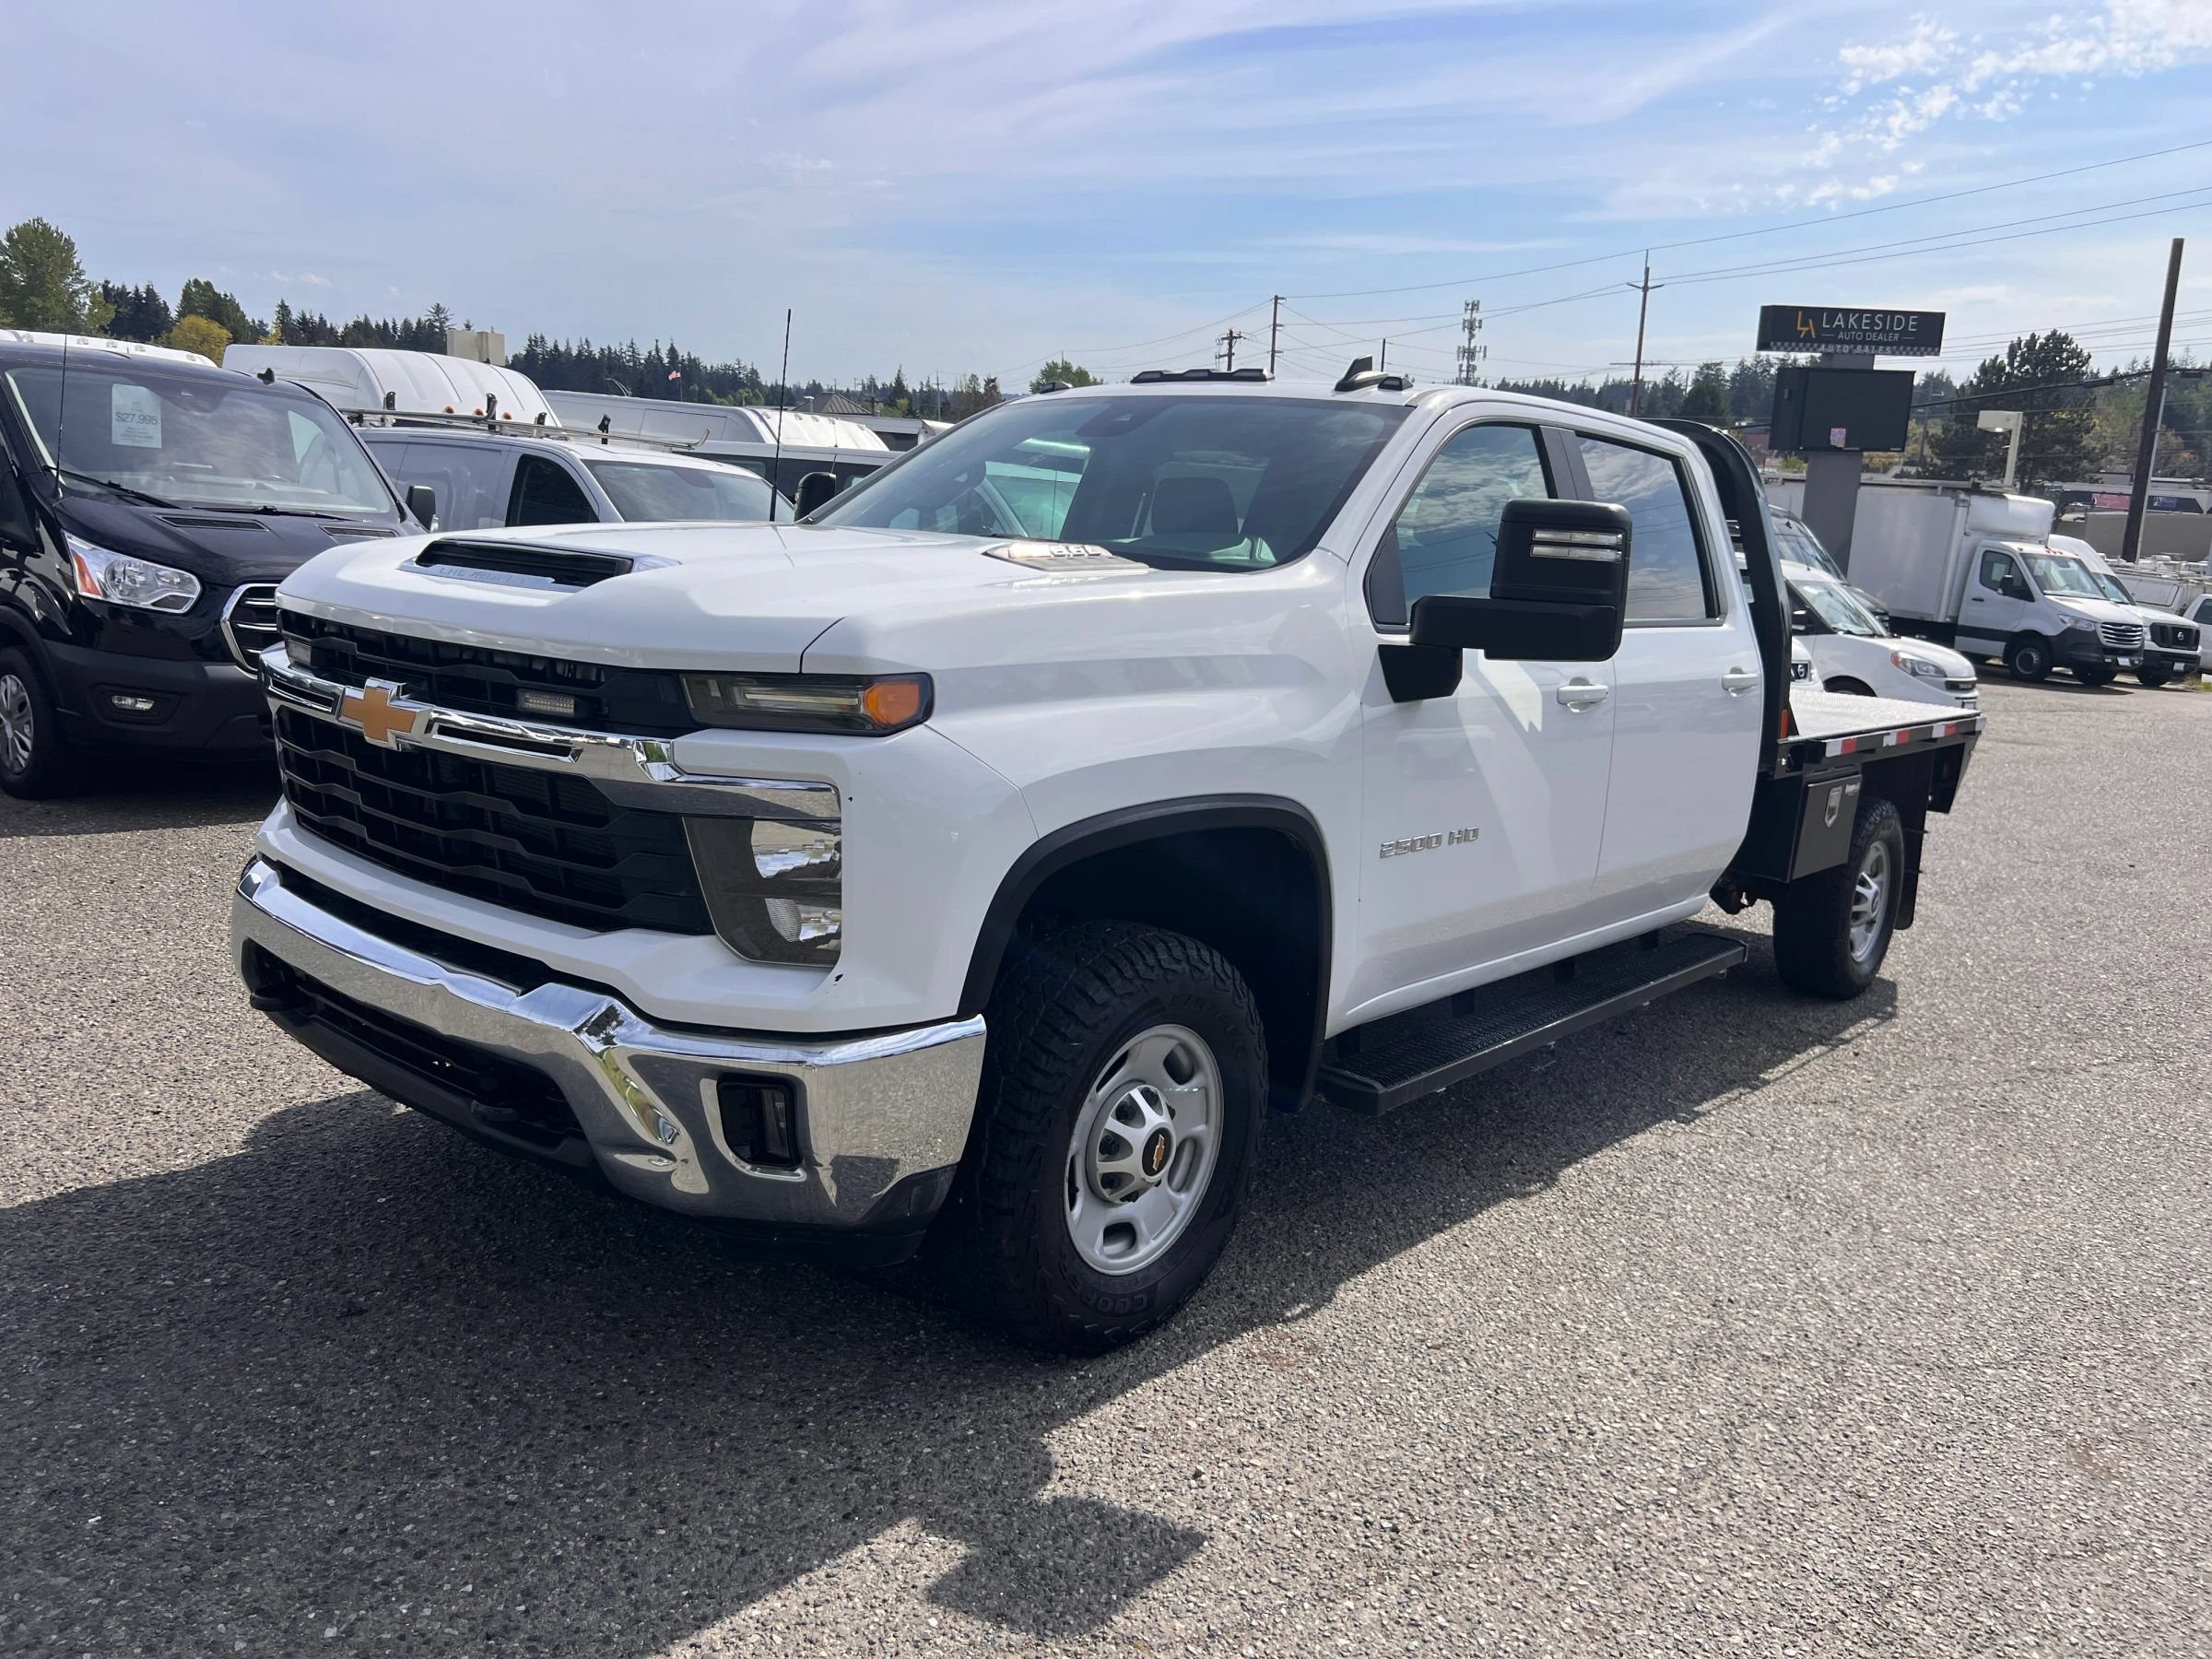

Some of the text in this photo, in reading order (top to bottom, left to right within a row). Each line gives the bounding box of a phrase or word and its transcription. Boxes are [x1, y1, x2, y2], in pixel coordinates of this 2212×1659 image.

[1822, 312, 1918, 331] LAKESIDE
[1838, 332, 1899, 342] AUTO DEALER
[1819, 344, 1893, 355] AUTO SALES
[1380, 827, 1479, 859] 2500 HD
